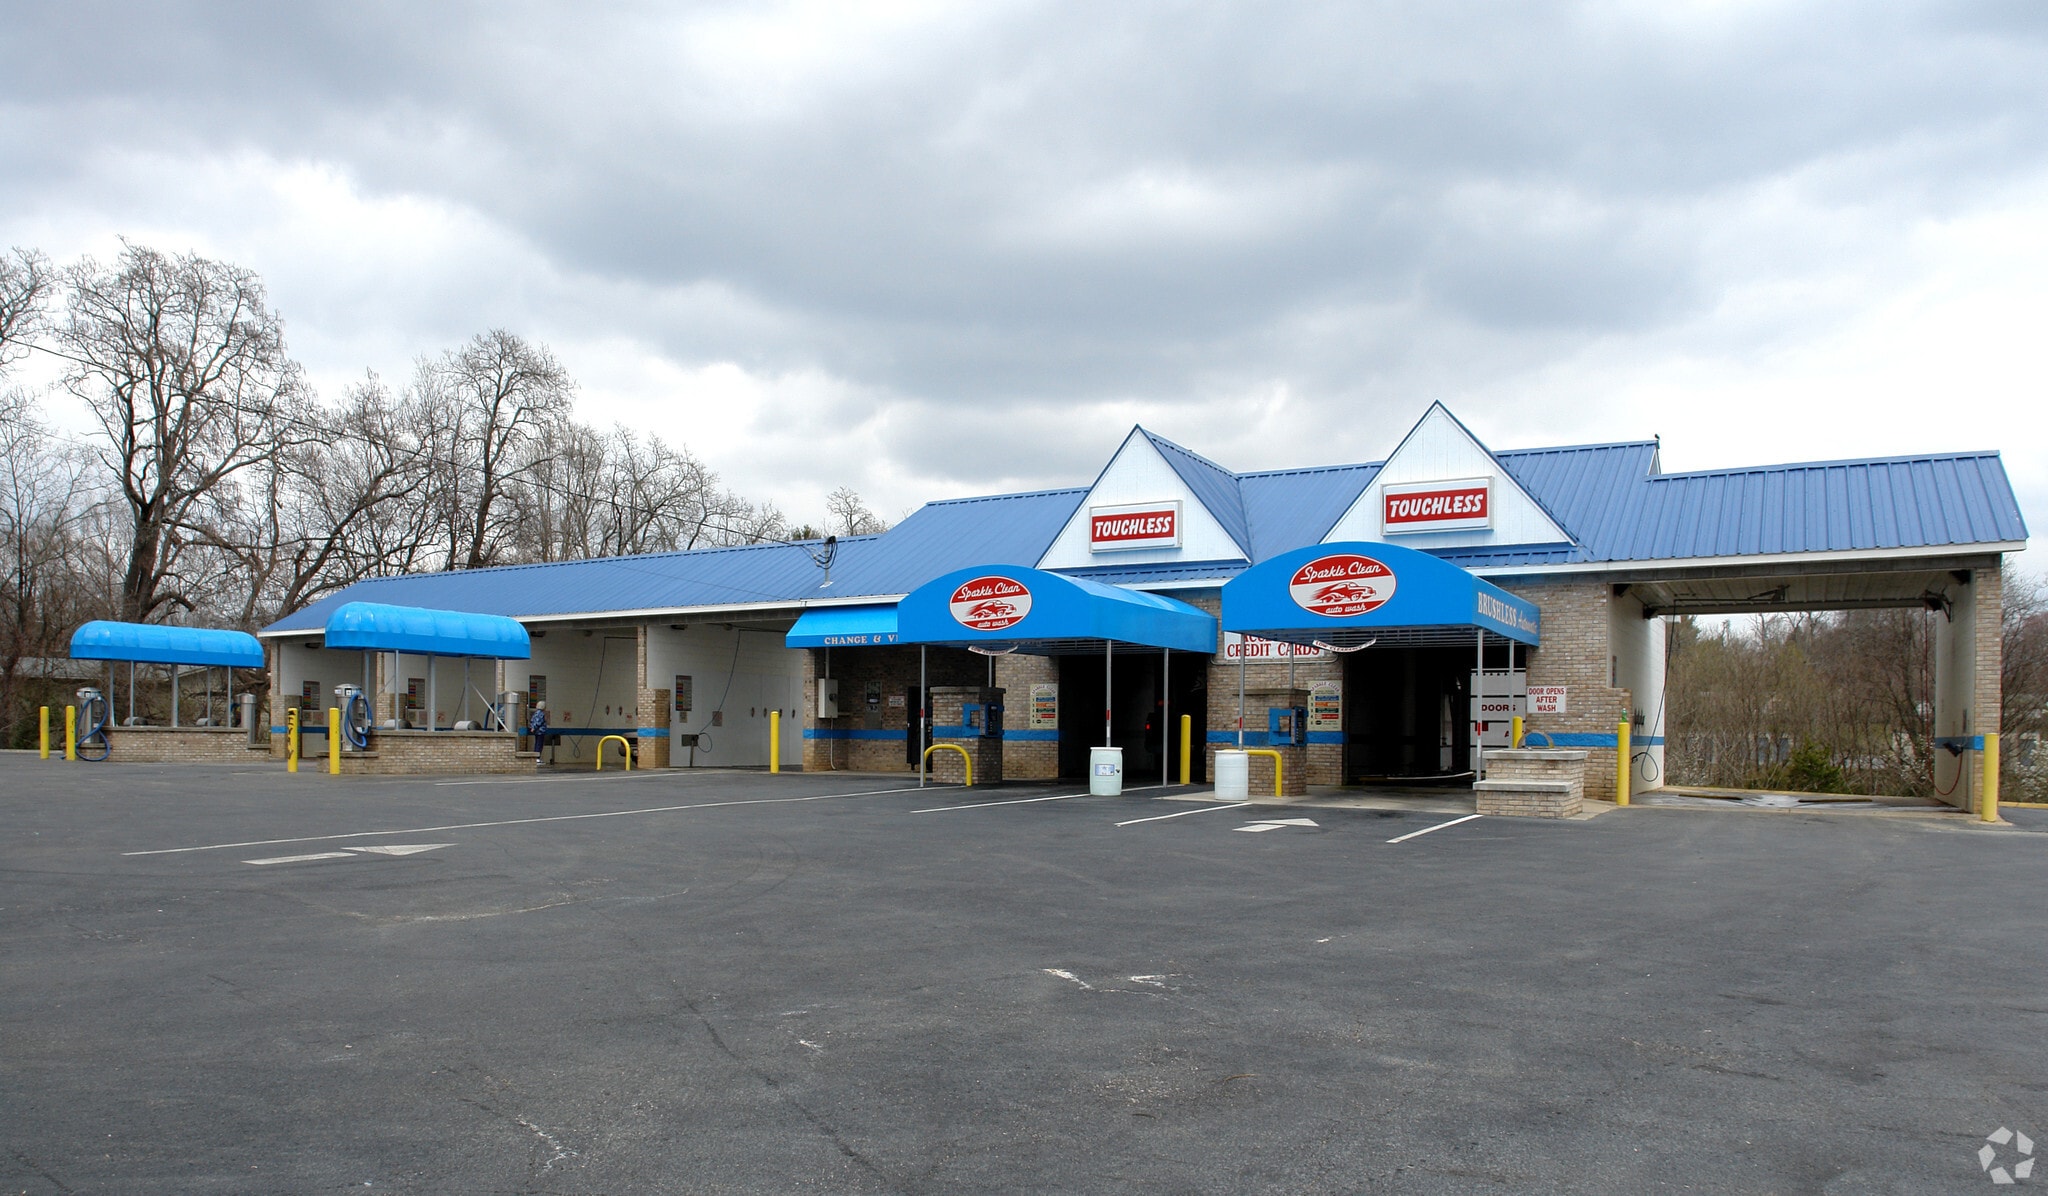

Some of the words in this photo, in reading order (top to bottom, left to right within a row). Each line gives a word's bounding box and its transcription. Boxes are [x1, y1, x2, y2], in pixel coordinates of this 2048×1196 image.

[1390, 494, 1484, 518] TOUCHLESS
[1095, 516, 1172, 538] TOUCHLESS
[1300, 565, 1346, 583] Sparkle
[1348, 561, 1381, 575] Clean
[957, 585, 993, 601] Sparkle
[994, 582, 1021, 595] Clean
[1325, 606, 1343, 614] auto
[1344, 603, 1367, 613] wash
[1477, 591, 1517, 628] BRUSHLESS
[977, 620, 990, 628] auto
[991, 618, 1009, 627] wash
[824, 635, 868, 645] CHANGE
[873, 634, 882, 643] &
[1227, 643, 1271, 657] CREDIT
[1277, 642, 1320, 656] CARDS
[1528, 687, 1544, 695] DOOR
[1546, 687, 1565, 695] OPENS
[1536, 704, 1556, 712] WASH
